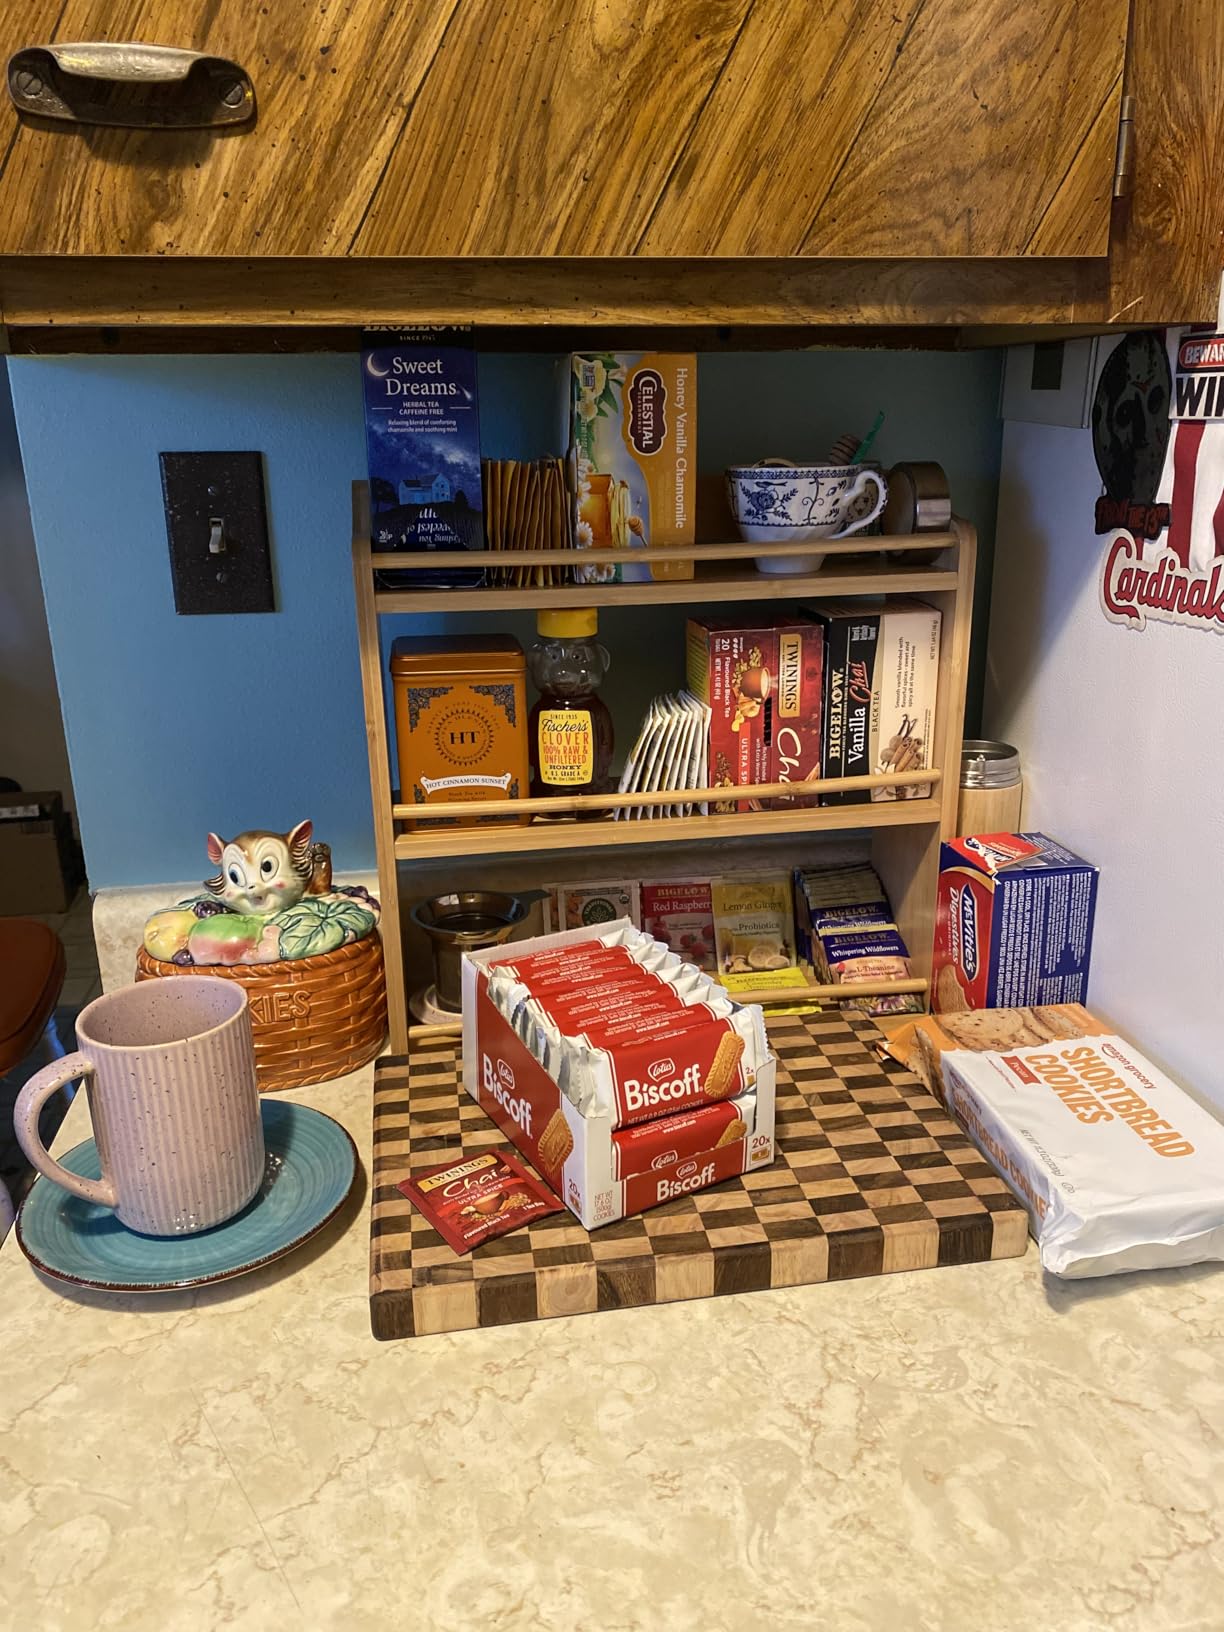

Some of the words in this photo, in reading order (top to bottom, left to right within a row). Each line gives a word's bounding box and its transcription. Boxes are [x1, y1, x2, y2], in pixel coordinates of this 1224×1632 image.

[393, 357, 443, 374] Sweet
[385, 378, 457, 395] Dreams
[674, 368, 688, 409] Honey
[639, 376, 657, 448] CELESTIAL
[676, 412, 688, 454] Vanilla
[675, 458, 687, 528] Chamomile
[721, 639, 730, 650] 20
[785, 641, 798, 710] TWININGS
[847, 661, 871, 703] Chai
[829, 670, 844, 760] BIGELOW
[542, 719, 588, 732] Fischer's
[449, 731, 480, 745] HT
[542, 732, 589, 745] CLOVER
[848, 707, 866, 764] Vanilla
[544, 745, 560, 754] 100%
[564, 746, 579, 754] RAW
[583, 745, 588, 754] &
[545, 755, 587, 764] UNFILTERED
[443, 778, 477, 786] CINNAMON
[657, 887, 708, 896] BIGELOW
[653, 902, 670, 912] Red
[724, 902, 752, 911] Lemon
[826, 905, 877, 918] BIGELOW
[739, 922, 779, 931] Probiotics
[950, 887, 959, 964] Digestives
[964, 894, 976, 972] McVitie's
[834, 933, 888, 943] BIGELOW
[832, 947, 866, 957] Whispering
[866, 945, 898, 953] Wildflowers
[653, 1062, 672, 1076] Lotus
[746, 1066, 754, 1074] 2x
[1011, 1062, 1029, 1078] Pecan
[1102, 1044, 1129, 1066] amazon
[1127, 1064, 1156, 1090] grocery
[483, 1053, 532, 1136] Biscoff
[624, 1064, 701, 1111] Biscoff
[1025, 1054, 1114, 1124] COOKIES
[1061, 1046, 1195, 1158] SHORTBREAD
[752, 1136, 770, 1148] 20x
[428, 1160, 488, 1185] TWININGS
[680, 1164, 694, 1176] Lotus
[443, 1169, 498, 1197] Chai
[569, 1179, 581, 1200] 20x
[657, 1163, 714, 1201] Biscoff
[458, 1194, 481, 1205] ULTRA
[483, 1184, 503, 1194] SPICE
[464, 1222, 488, 1240] Flavoured
[501, 1214, 510, 1222] Tea
